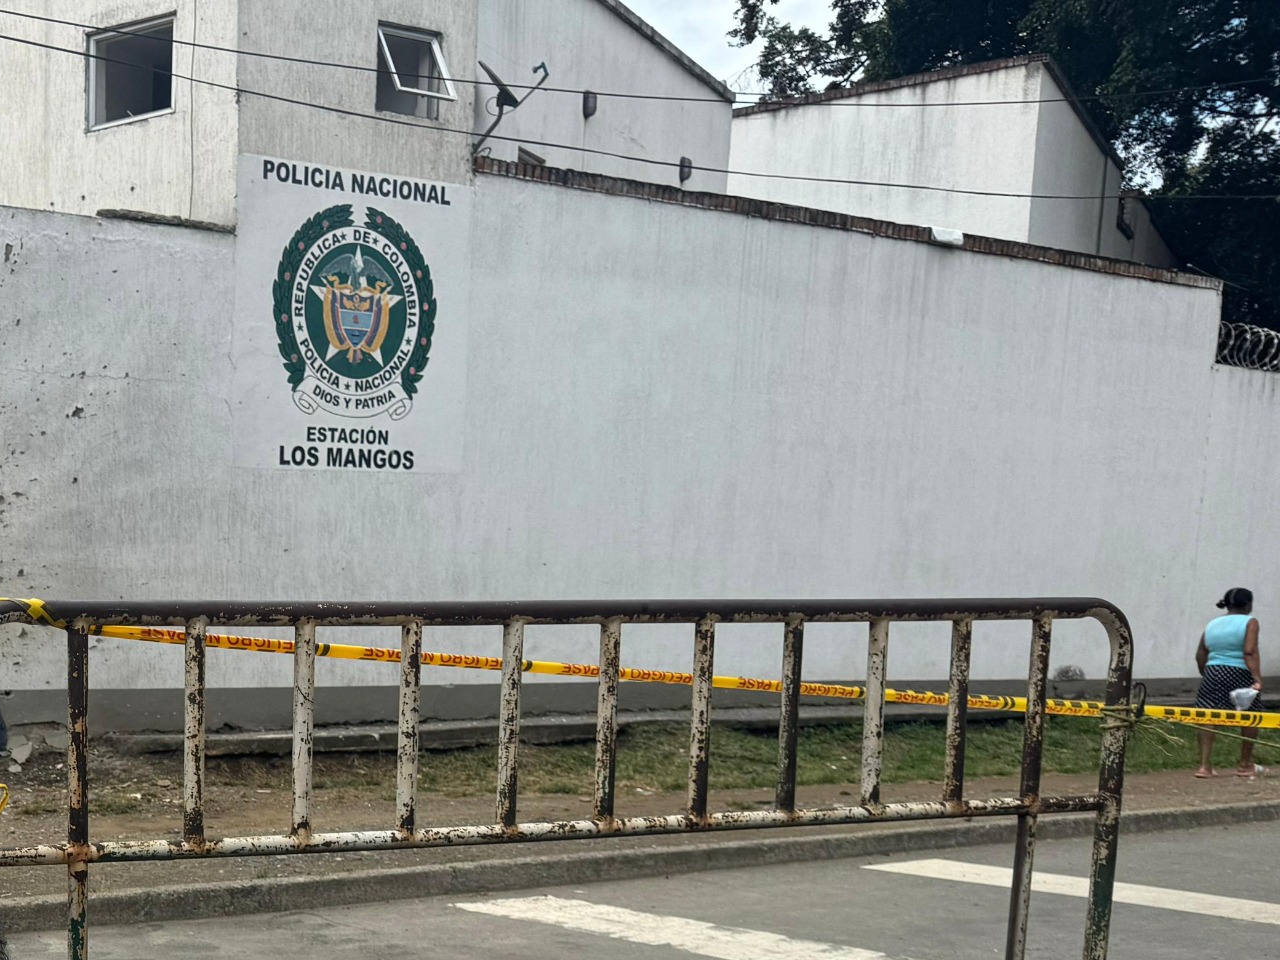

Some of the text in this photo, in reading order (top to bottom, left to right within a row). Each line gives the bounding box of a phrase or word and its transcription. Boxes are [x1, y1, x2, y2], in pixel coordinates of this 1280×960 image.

[263, 159, 450, 206] POLICIA NACIONAL
[294, 229, 417, 329] REPUBLICA DE COLOMBIA
[299, 337, 411, 393] POLICIA NACIONAL
[312, 384, 396, 410] DIOS Y PATRIA
[306, 425, 389, 445] ESTACIÓN
[279, 445, 414, 470] LOS MANGOS
[227, 635, 294, 650] ELIGRO
[439, 654, 503, 668] ELIGRO
[562, 662, 600, 675] PASE
[738, 677, 771, 690] PASE
